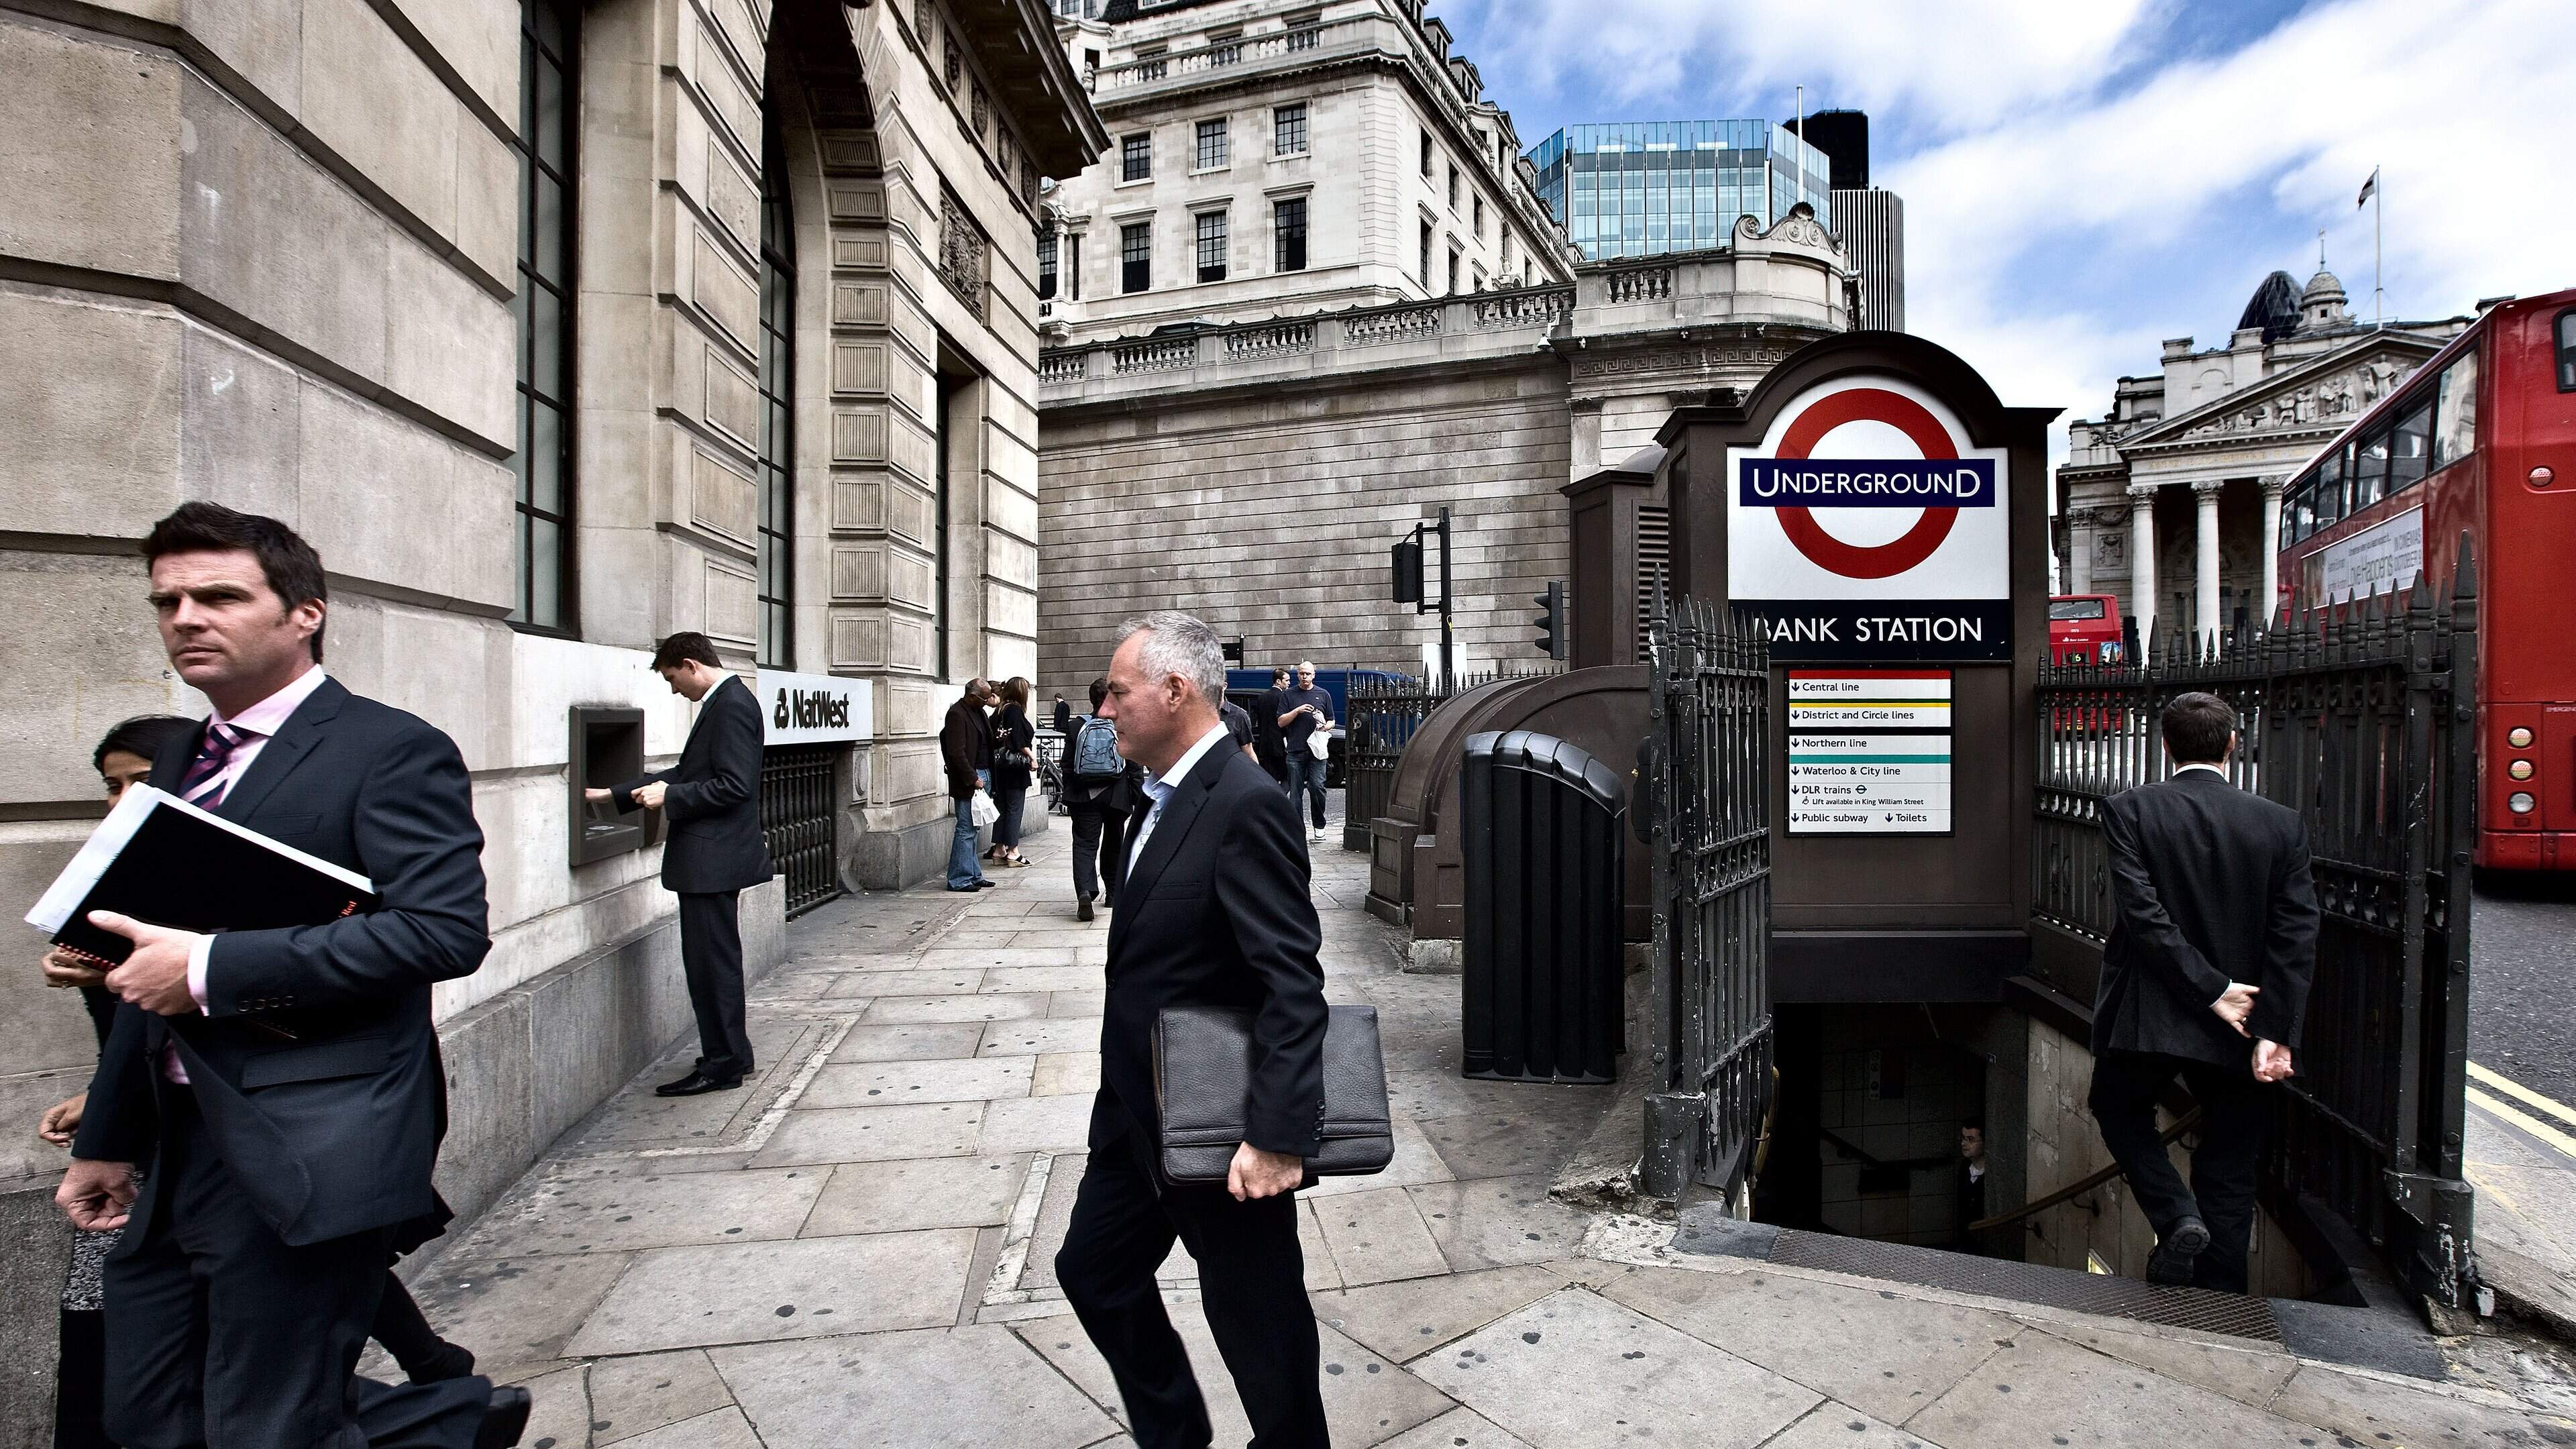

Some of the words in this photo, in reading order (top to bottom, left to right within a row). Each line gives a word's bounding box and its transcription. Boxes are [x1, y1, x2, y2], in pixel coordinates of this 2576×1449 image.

[1754, 468, 1980, 497] UNDERGROUND
[1856, 617, 1982, 642] STATION
[1802, 682, 1839, 692] Central
[1841, 682, 1860, 692] line
[792, 688, 849, 729] NatWest
[1802, 710, 1839, 720] District
[1841, 710, 1859, 720] and
[1862, 710, 1889, 720] Circle
[1892, 710, 1915, 720] lines
[1802, 739, 1846, 747] Northern
[1849, 739, 1867, 747] line
[1802, 766, 1847, 775] Waterloo
[1849, 767, 1857, 775] &
[1860, 766, 1881, 777] City
[1883, 766, 1900, 775] line
[1802, 786, 1821, 794] DLR
[1823, 786, 1851, 794] trains
[1862, 798, 1876, 806] King
[1802, 813, 1831, 822] Public
[1833, 813, 1868, 824] subway
[1895, 813, 1927, 822] Toilets
